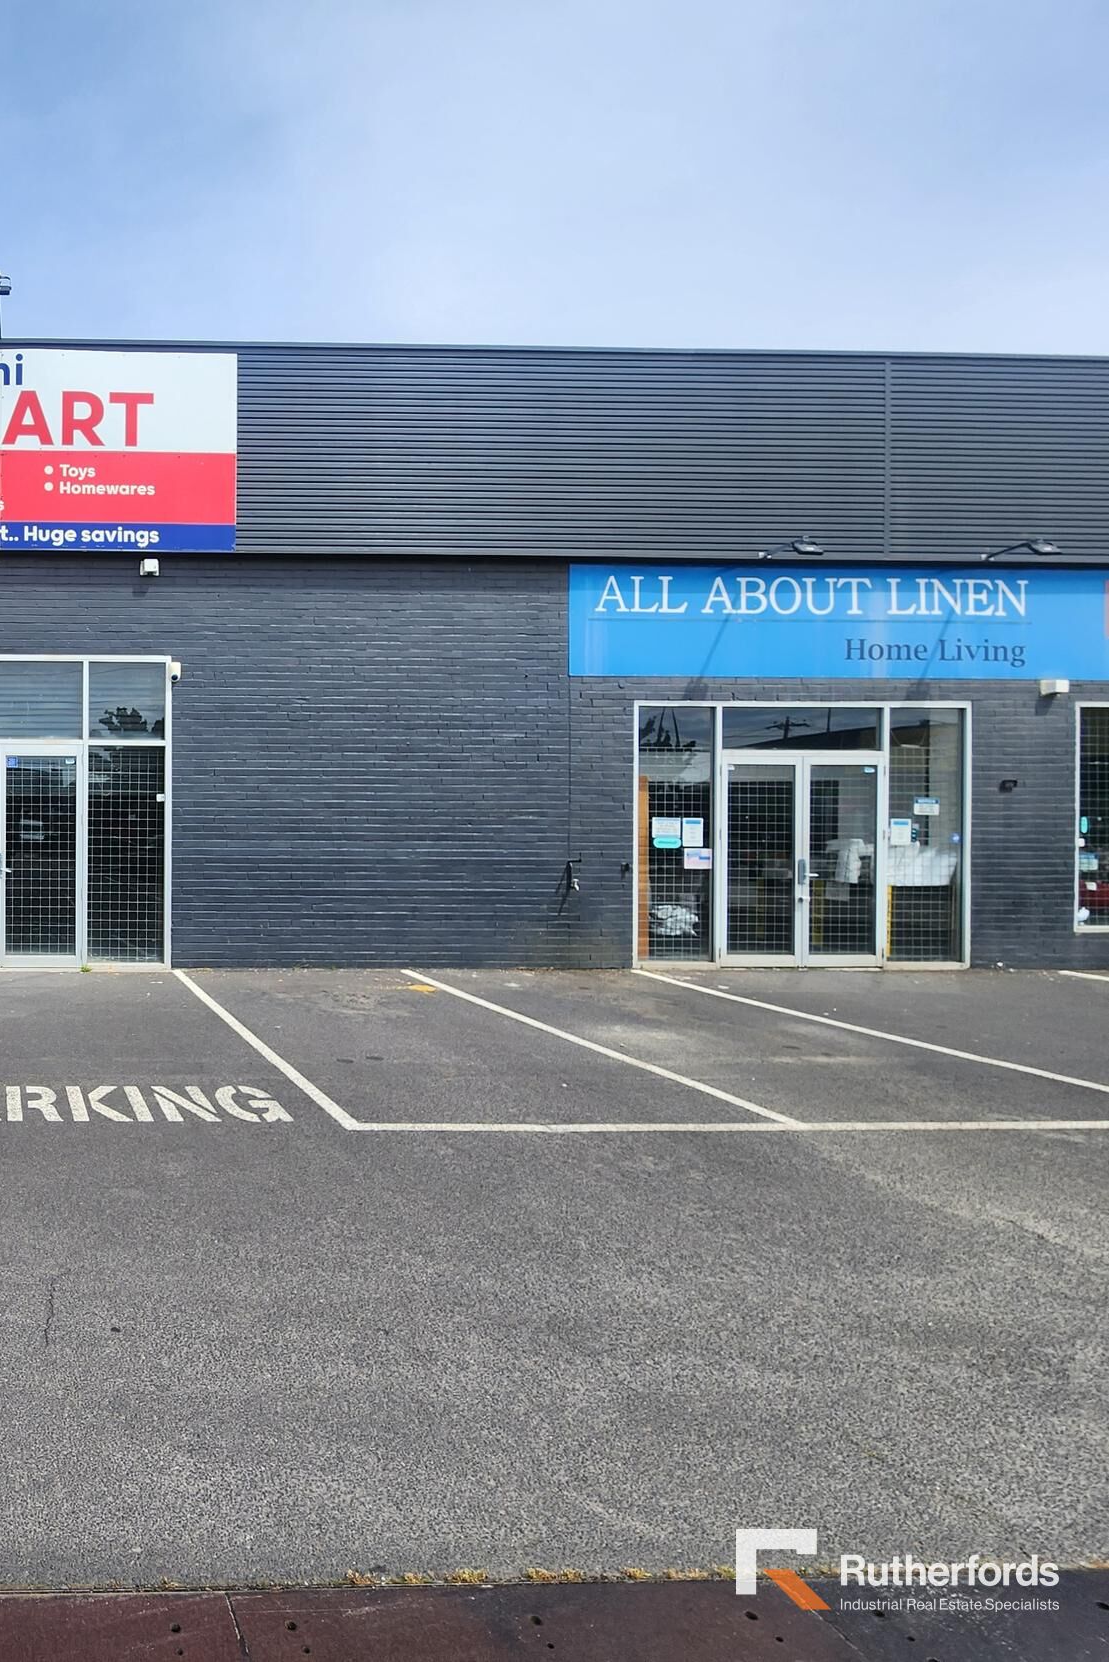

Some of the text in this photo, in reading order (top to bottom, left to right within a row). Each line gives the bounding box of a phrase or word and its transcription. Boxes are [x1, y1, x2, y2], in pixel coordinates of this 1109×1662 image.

[59, 464, 96, 480] Toys
[59, 480, 156, 496] Homewares
[23, 525, 77, 546] Huge
[81, 527, 160, 546] savings
[595, 575, 1029, 617] ALL ABOUT LINEN
[844, 638, 1026, 668] Home Living
